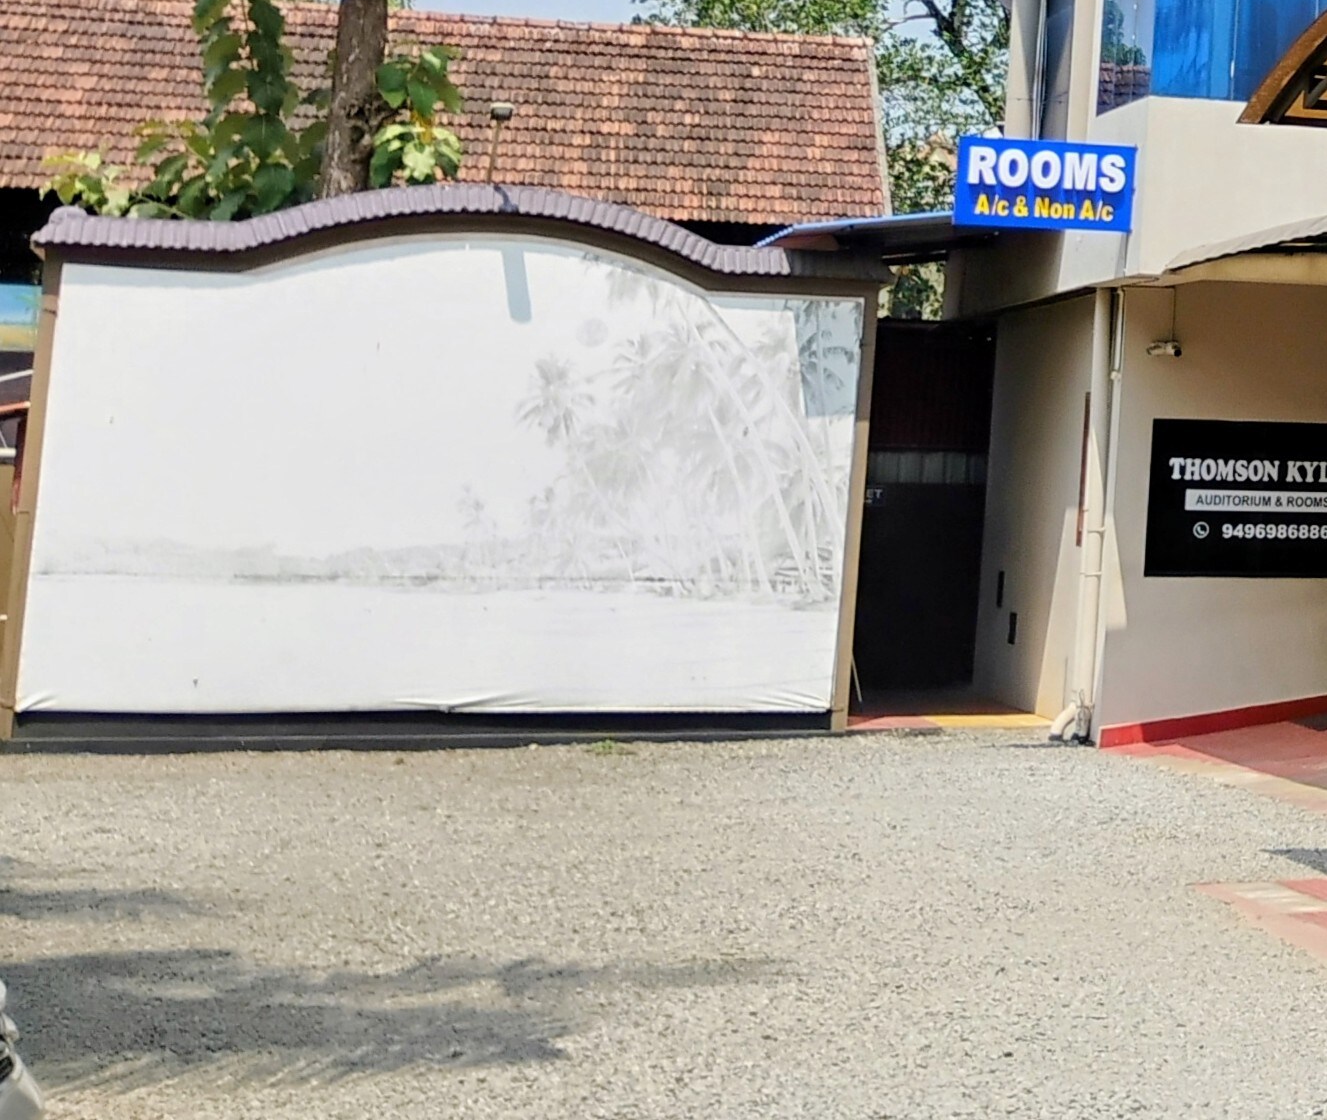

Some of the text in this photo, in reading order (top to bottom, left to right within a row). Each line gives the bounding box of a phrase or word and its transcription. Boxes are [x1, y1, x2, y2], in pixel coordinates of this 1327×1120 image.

[968, 146, 1127, 192] ROOMS
[974, 194, 1114, 222] A/c & Non A/c
[1169, 457, 1280, 481] THOMSON
[1196, 494, 1271, 507] AUDITORIUM
[1274, 495, 1284, 507] &
